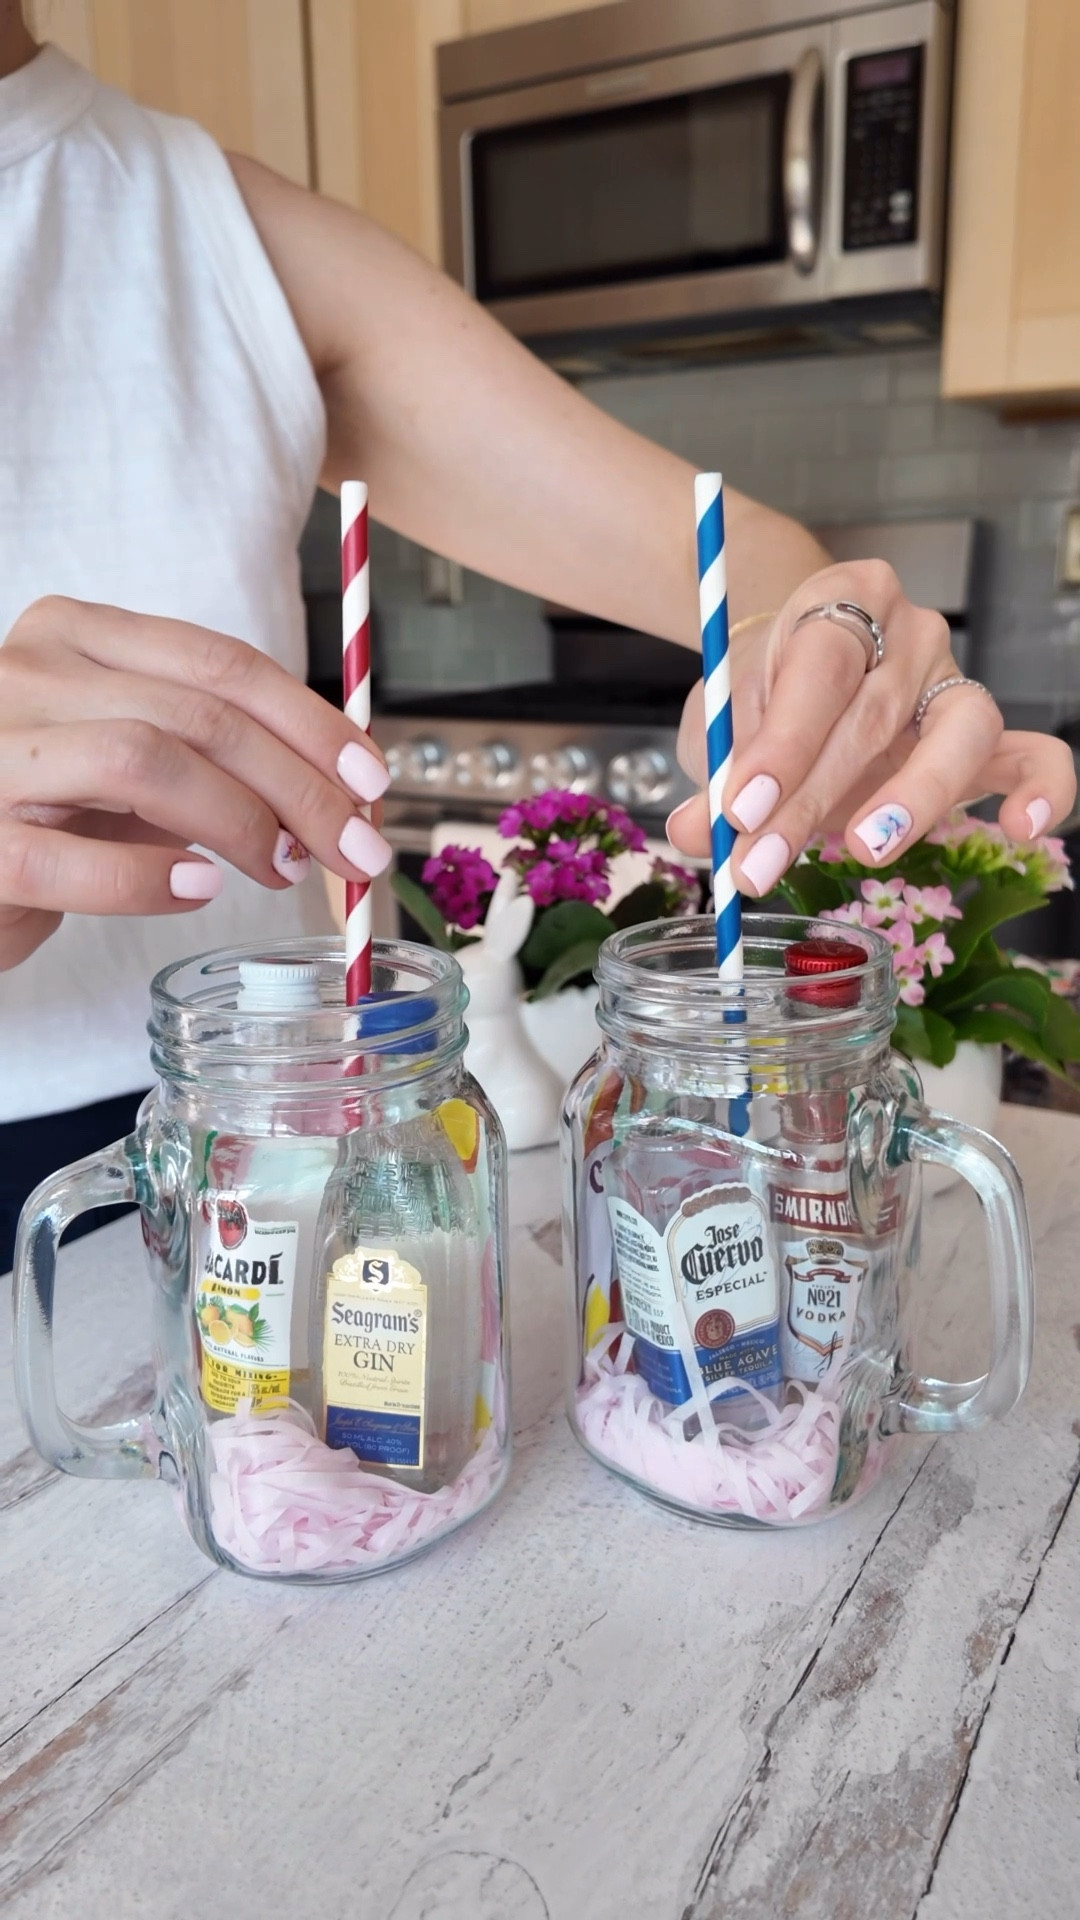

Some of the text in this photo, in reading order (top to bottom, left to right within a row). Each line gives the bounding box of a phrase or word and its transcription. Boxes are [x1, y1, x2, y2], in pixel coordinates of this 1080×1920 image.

[774, 1193, 855, 1226] SMIRNO
[704, 1223, 740, 1249] Jose
[681, 1236, 764, 1286] Cuervo
[696, 1273, 765, 1301] ESPECIAL
[331, 1301, 420, 1334] Seagram's
[796, 1307, 846, 1323] VODKA
[334, 1333, 416, 1356] EXTRA DRY
[737, 1344, 778, 1367] AGAVE
[353, 1350, 395, 1373] GIN
[738, 1360, 774, 1373] TEQUILA
